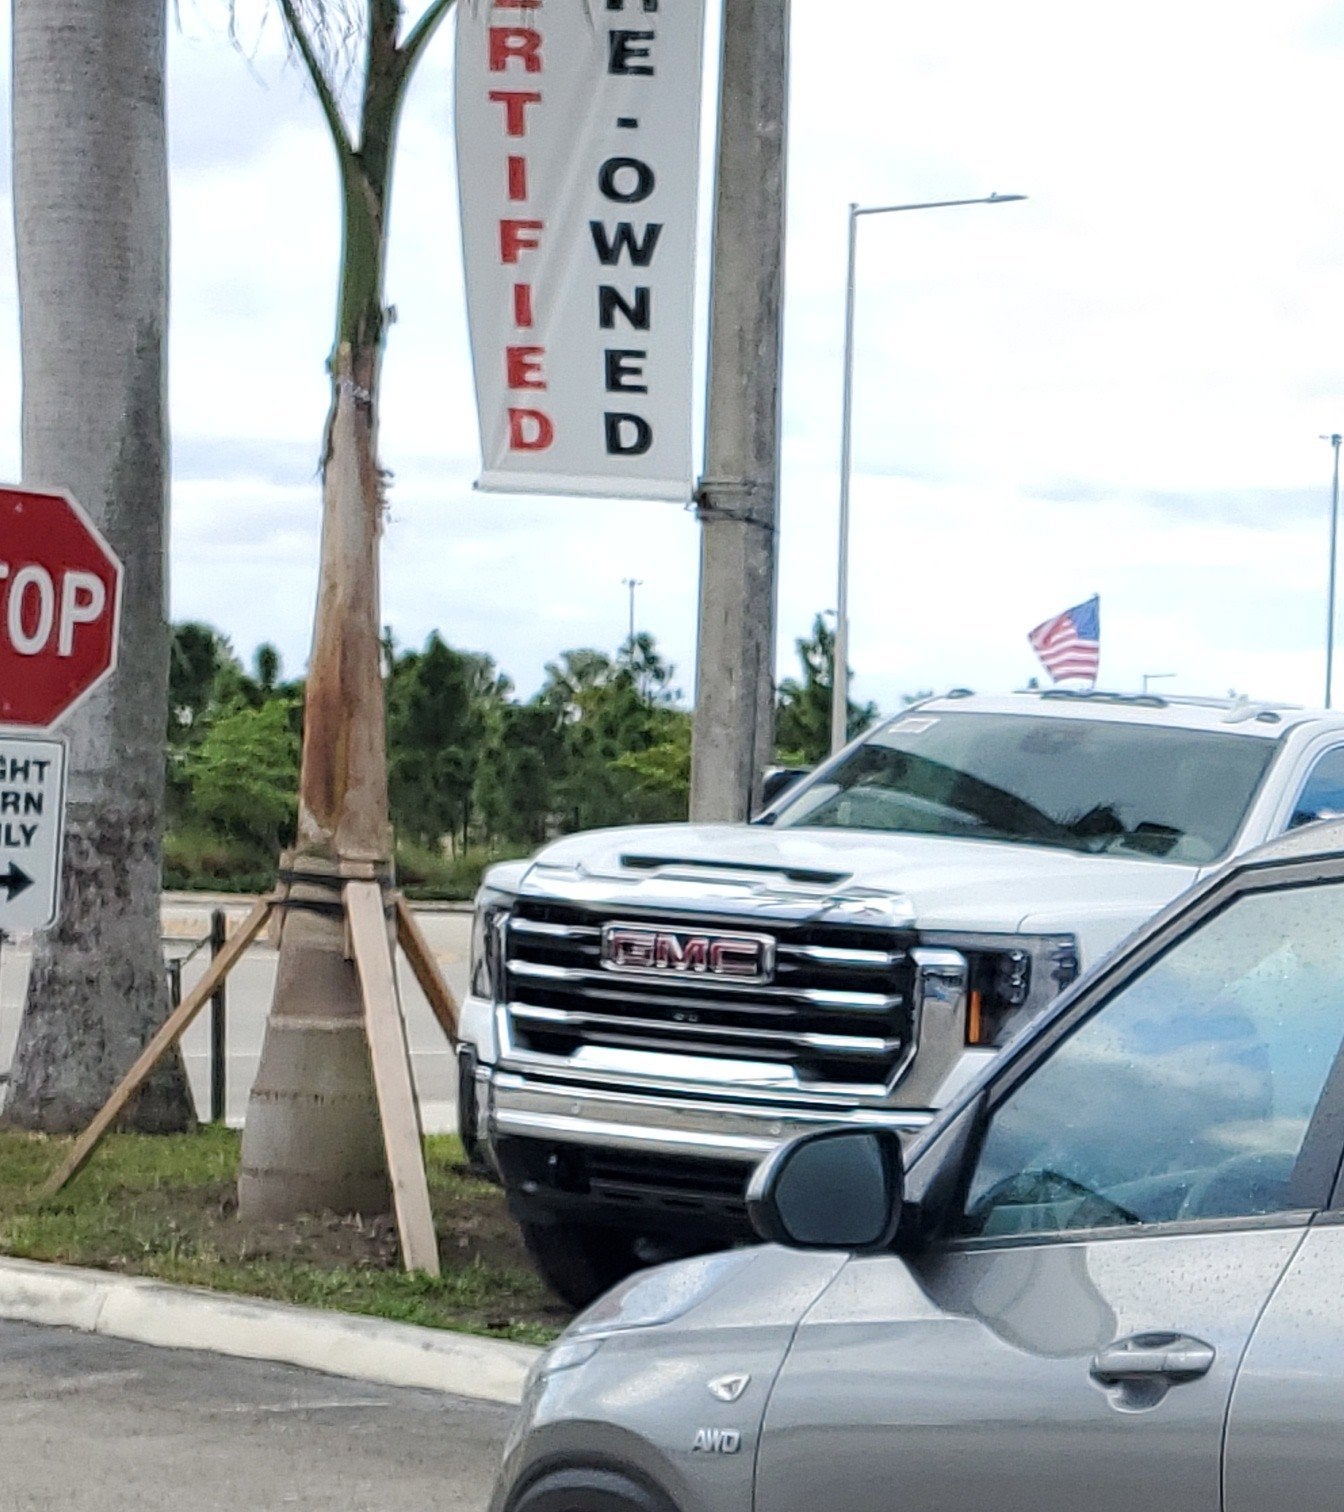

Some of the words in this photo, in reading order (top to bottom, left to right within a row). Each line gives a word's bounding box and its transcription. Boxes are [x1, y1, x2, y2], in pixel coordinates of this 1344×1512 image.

[487, 0, 555, 452] RTIFIED
[590, 0, 664, 456] E-OWNED
[0, 562, 106, 658] OP
[0, 823, 39, 848] LY
[613, 928, 759, 975] GMC
[692, 1428, 741, 1454] AWD
